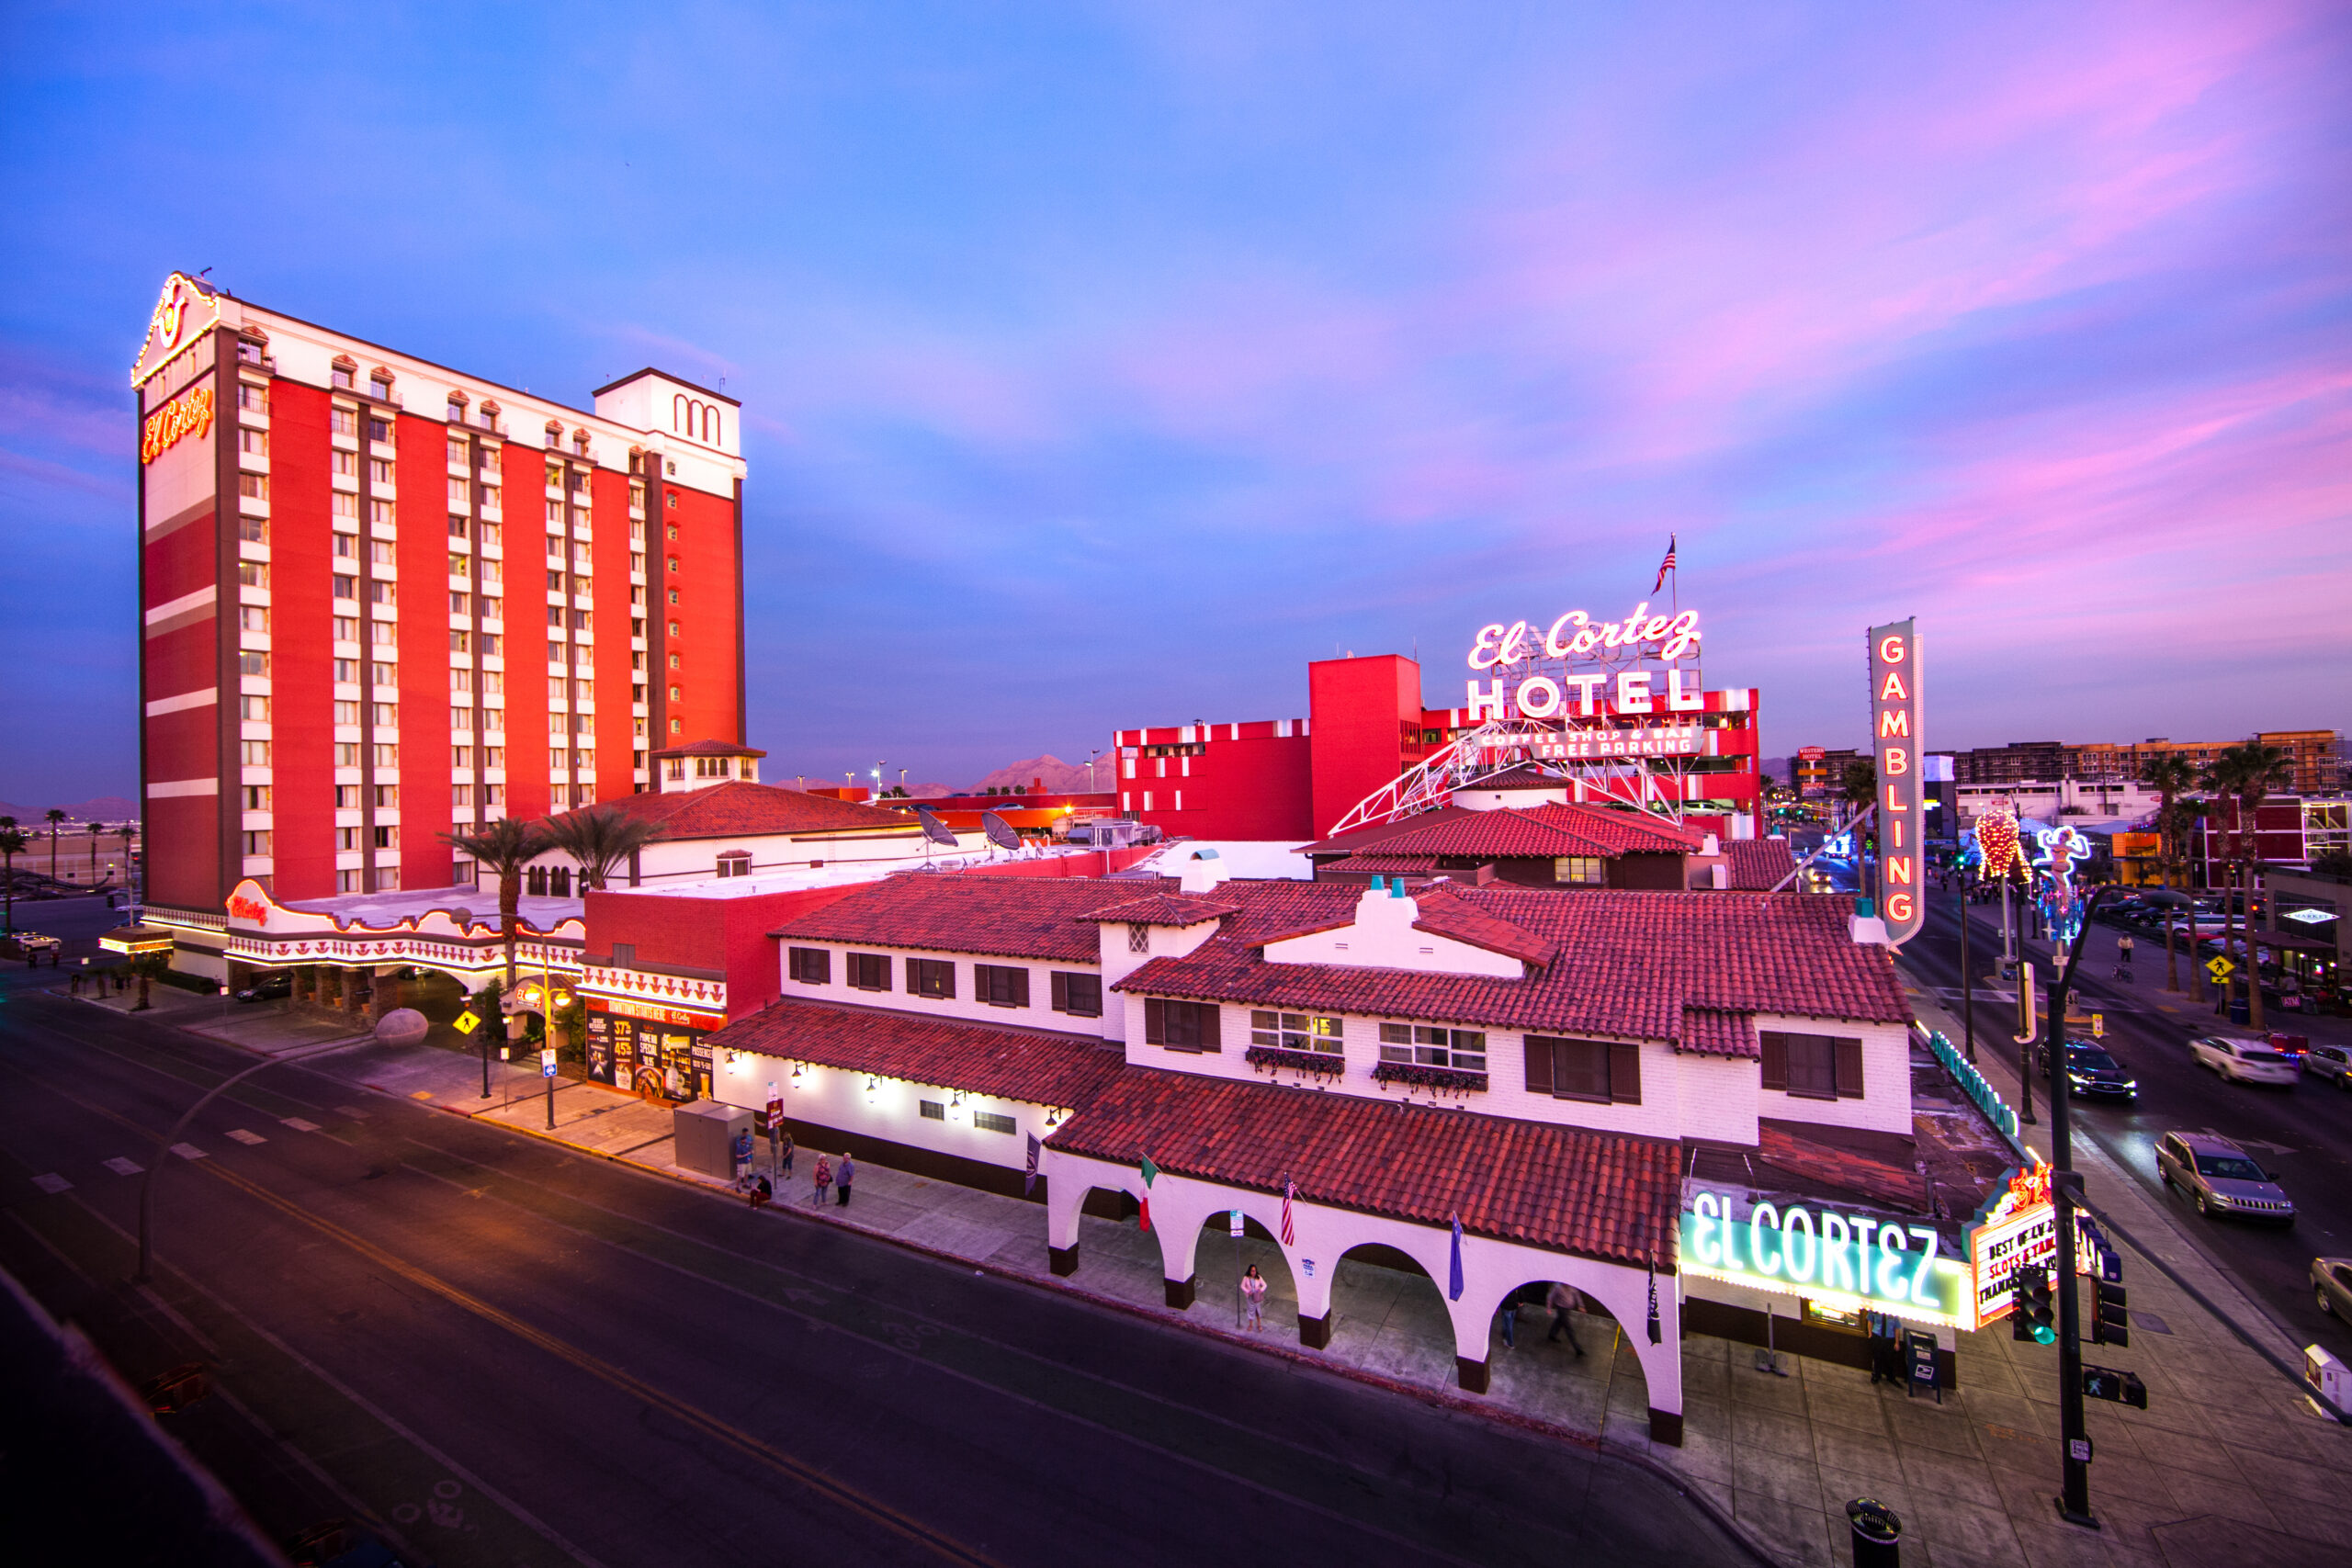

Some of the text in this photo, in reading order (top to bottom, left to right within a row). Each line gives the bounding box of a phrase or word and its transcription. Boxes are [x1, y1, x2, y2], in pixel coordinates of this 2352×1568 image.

[141, 387, 213, 465] El Cortez
[1467, 602, 1702, 671] El Cortez
[1467, 669, 1704, 721] HOTEL
[1481, 728, 1693, 747] COFFEE SHOP & BAR
[1542, 739, 1692, 757] FREE PARKING
[1880, 636, 1914, 921] GAMBLING
[2284, 998, 2300, 1007] ATM
[614, 1041, 632, 1056] 45%
[1693, 1190, 1940, 1308] EL CORTEZ
[1989, 1236, 2014, 1260] BEST
[2018, 1229, 2028, 1247] OF
[2031, 1222, 2044, 1238] LV
[1989, 1253, 2020, 1279] SLOTS
